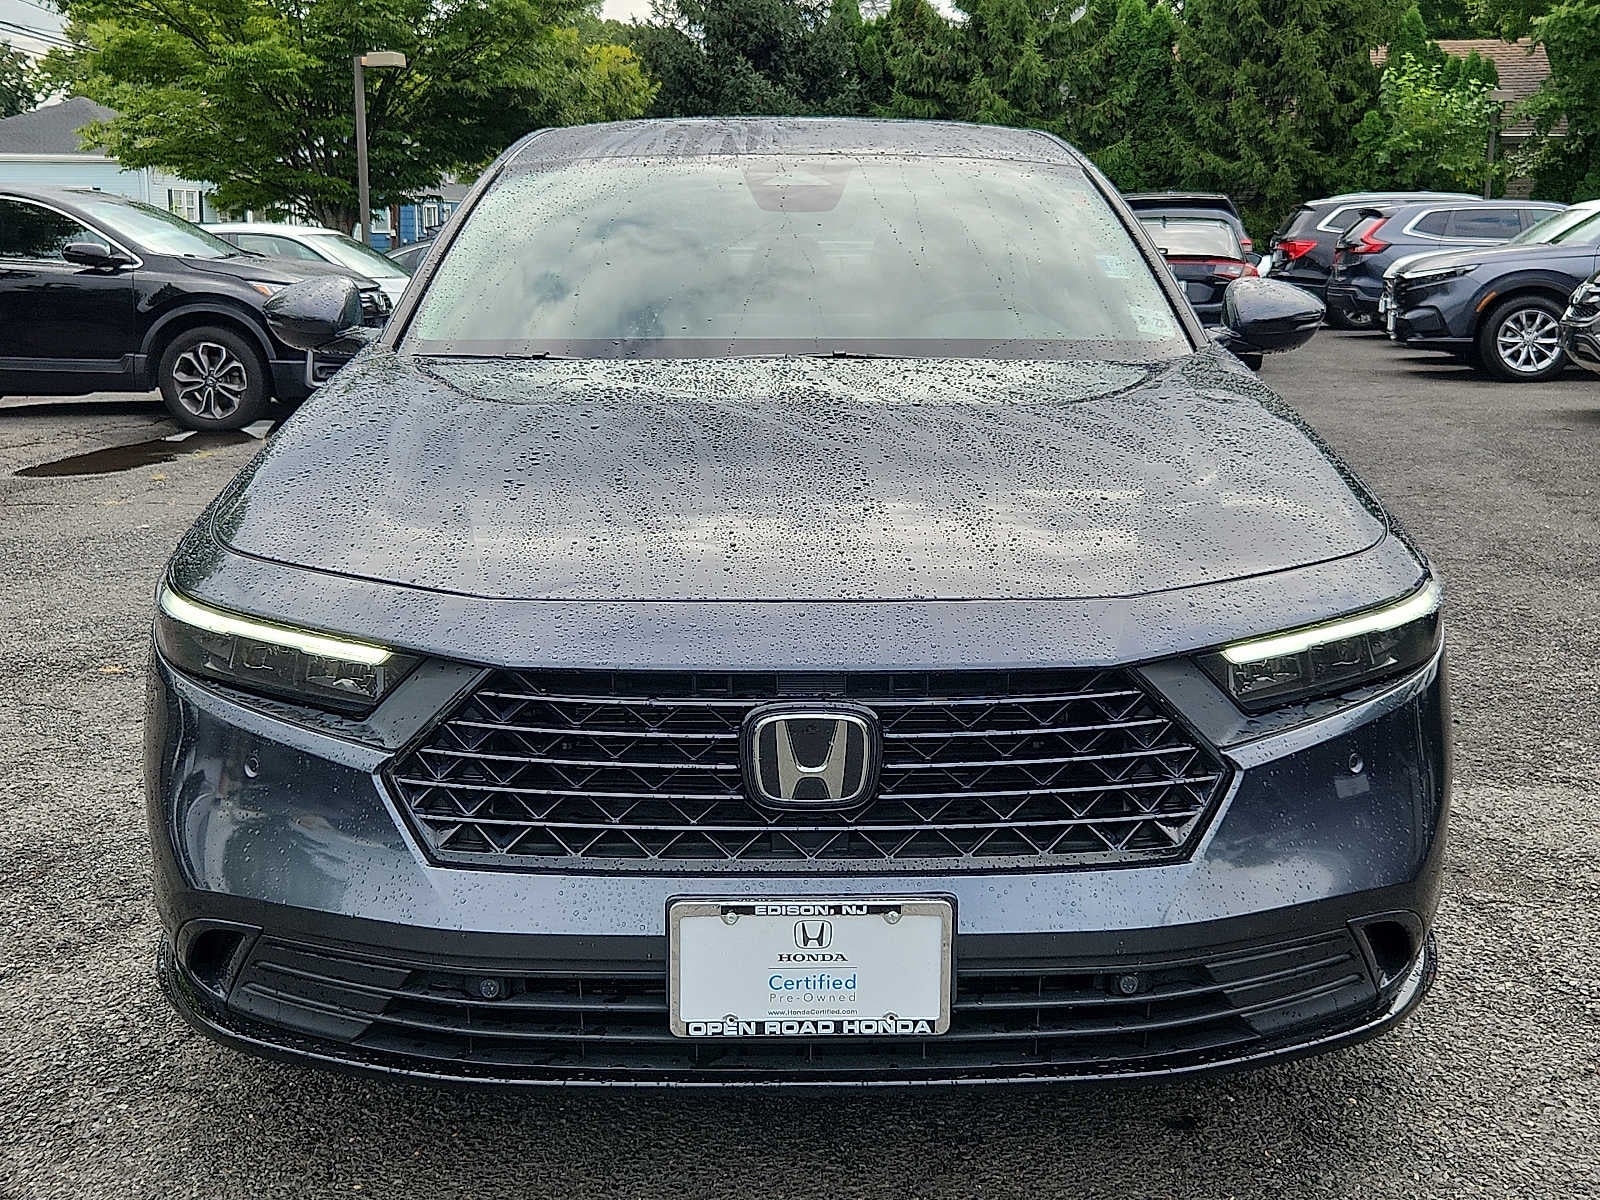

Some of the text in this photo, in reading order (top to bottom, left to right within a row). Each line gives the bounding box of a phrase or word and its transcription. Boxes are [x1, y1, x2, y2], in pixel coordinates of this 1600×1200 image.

[754, 905, 868, 916] EDISON, NJ
[777, 953, 848, 962] HONDA
[768, 973, 857, 991] Certified
[769, 992, 856, 1003] Pre-Owned
[768, 1008, 858, 1016] www.HondaCertified.com
[688, 1019, 932, 1036] OPEN ROAD HONDA
